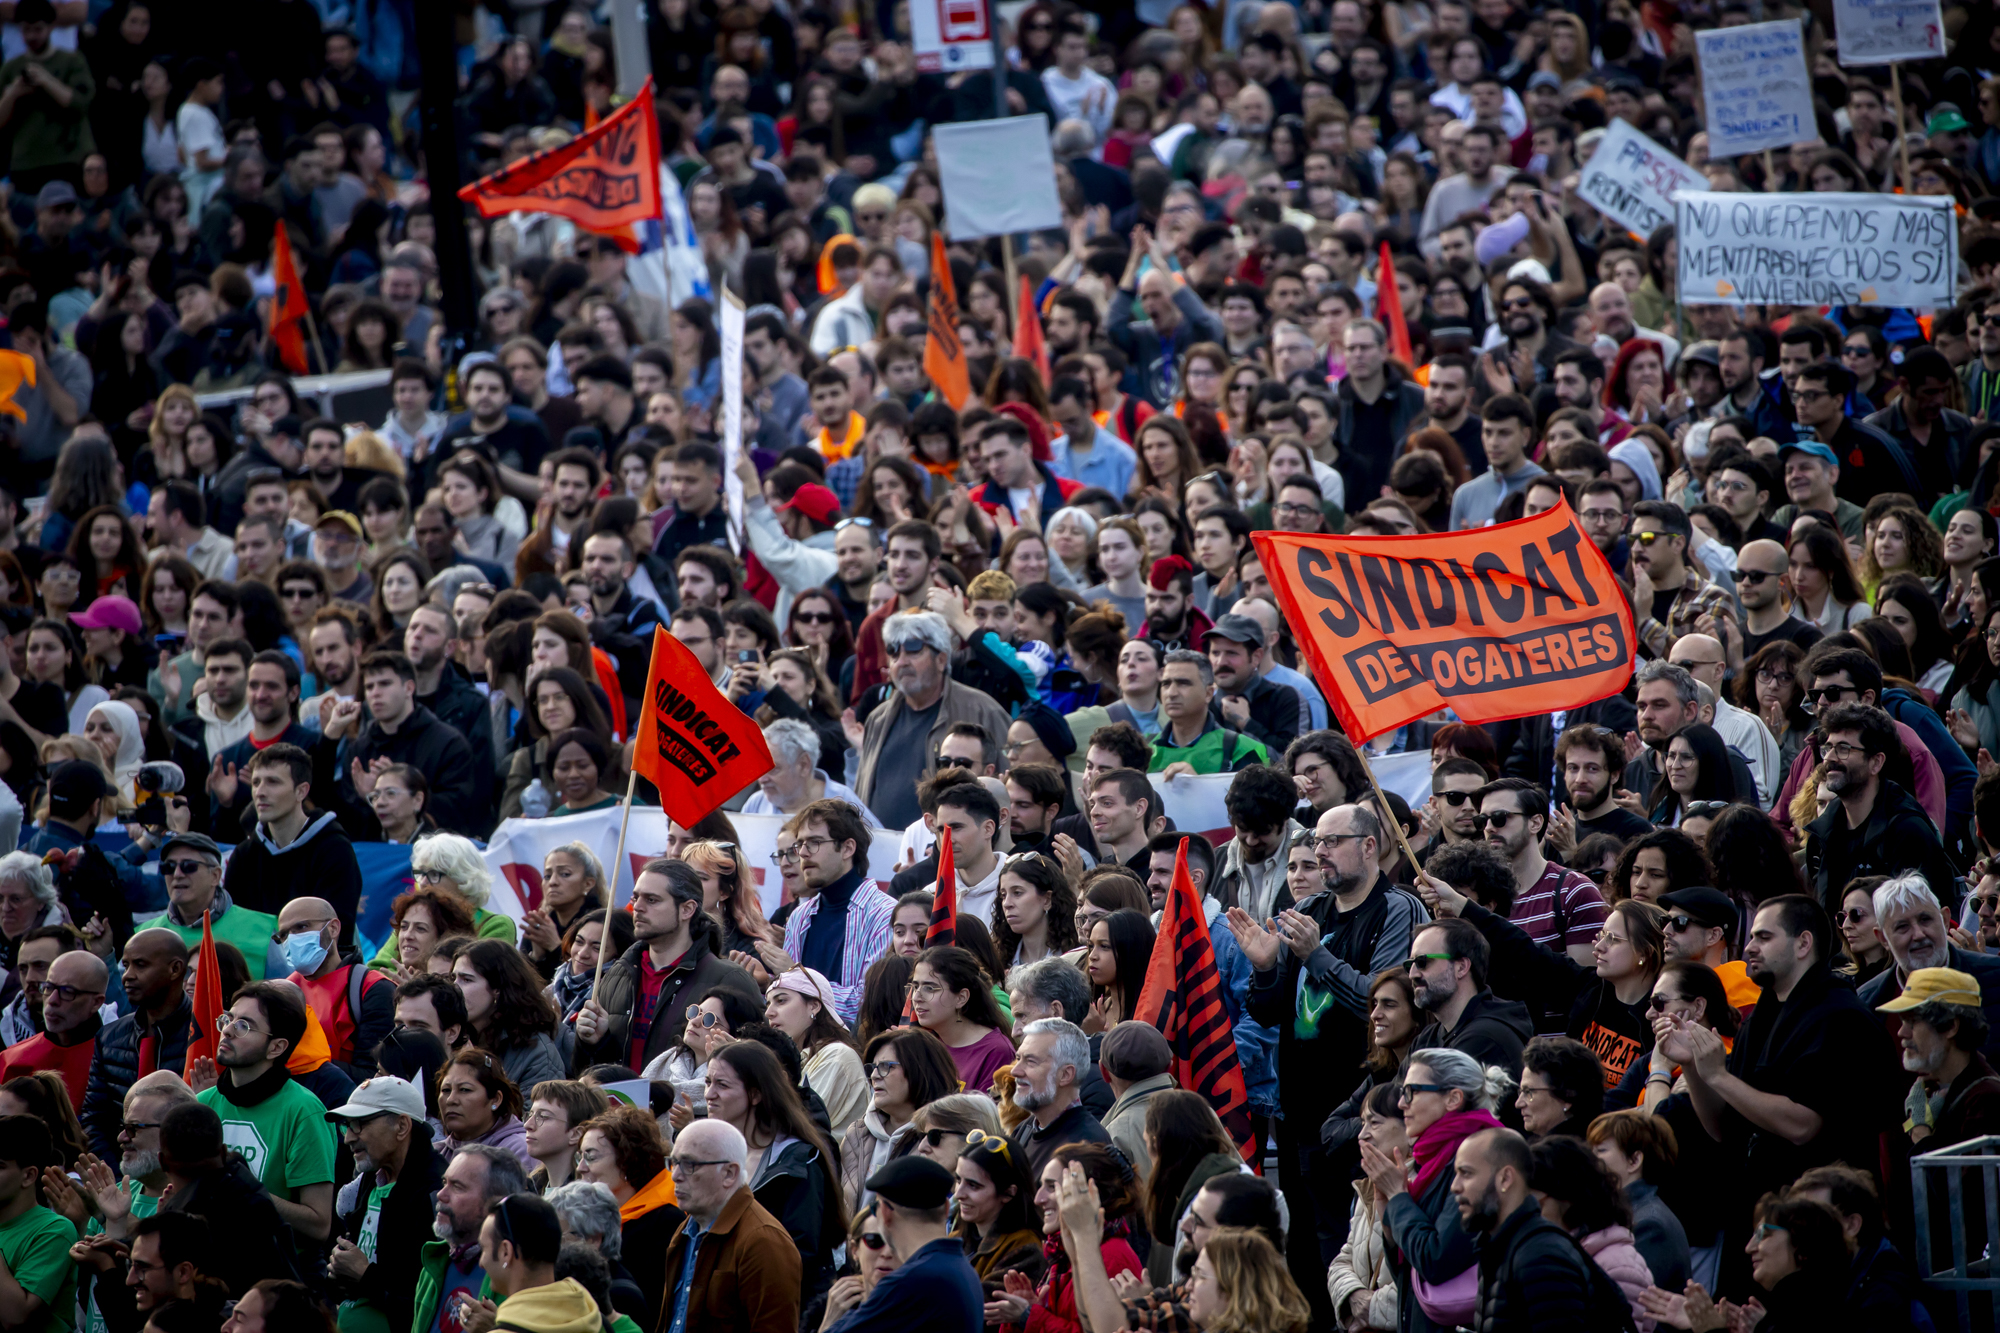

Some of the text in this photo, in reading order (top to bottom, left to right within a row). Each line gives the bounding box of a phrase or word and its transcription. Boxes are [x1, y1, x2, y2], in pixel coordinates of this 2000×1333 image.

[1685, 200, 1721, 239] NO
[1731, 201, 1880, 243] QUEREMOS
[1731, 274, 1862, 305] VIVIENDAS
[1297, 519, 1600, 638] SINDICAT
[1355, 646, 1412, 694] DE
